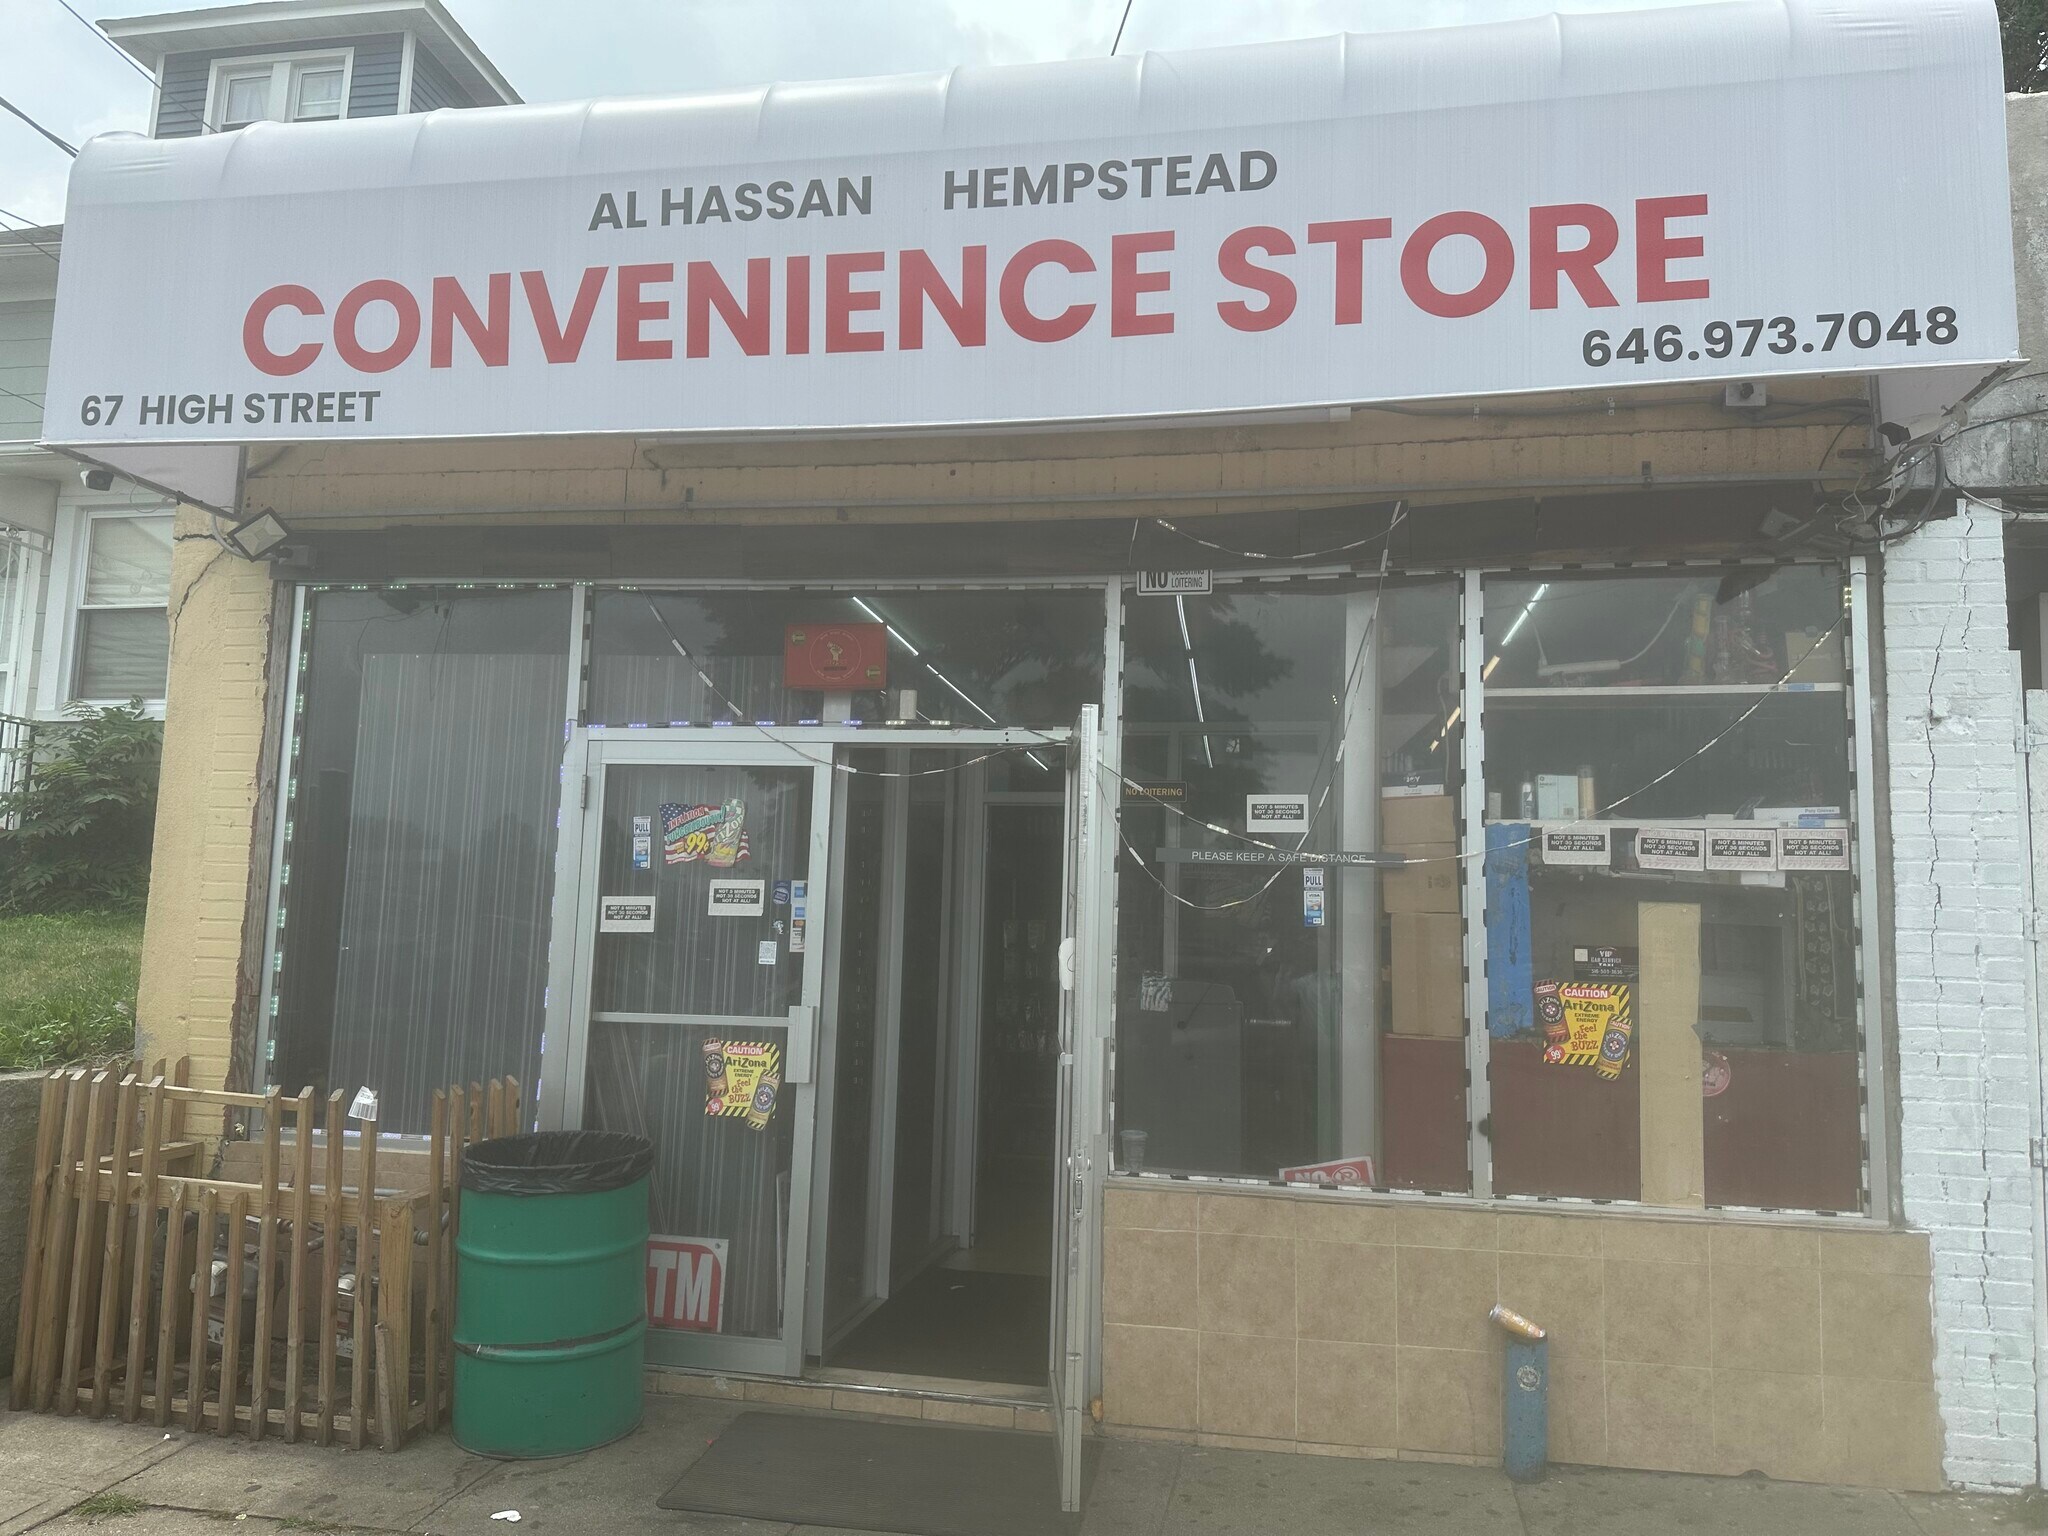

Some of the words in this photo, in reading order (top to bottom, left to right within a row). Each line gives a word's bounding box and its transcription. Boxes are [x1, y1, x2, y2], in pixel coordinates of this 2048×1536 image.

[588, 190, 647, 230] AL
[661, 176, 873, 226] HASSAN
[943, 149, 1278, 210] HEMPSTEAD
[242, 230, 1176, 377] CONVENIENCE
[1216, 194, 1710, 332] STORE
[1581, 305, 1959, 368] 646.973.7048
[80, 395, 124, 426] 67
[140, 393, 233, 424] HIGH
[244, 391, 381, 424] STREET
[1146, 571, 1168, 588] NO
[1171, 577, 1202, 588] LOITERING
[1125, 788, 1138, 796] NO
[1140, 788, 1183, 796] LOITERING
[667, 806, 705, 832] INFLATION
[634, 822, 649, 832] PULL
[1191, 851, 1233, 861] PLEASE
[1236, 852, 1265, 862] KEEP
[1267, 853, 1276, 862] A
[1278, 853, 1307, 862] SAFE
[1310, 853, 1366, 863] DISTANCE
[1305, 875, 1322, 886] PULL
[1599, 950, 1613, 958] VIP
[1564, 988, 1608, 998] CAUTION
[1563, 999, 1615, 1013] AriZona
[1579, 1024, 1597, 1034] Feel
[1573, 1030, 1588, 1040] the
[727, 1046, 763, 1055] CAUTION
[1570, 1040, 1599, 1051] BUZZ
[725, 1056, 767, 1068] AriZona
[737, 1079, 751, 1088] Feel
[731, 1085, 743, 1094] the
[728, 1093, 751, 1104] BUZZ
[650, 1248, 714, 1322] TM
